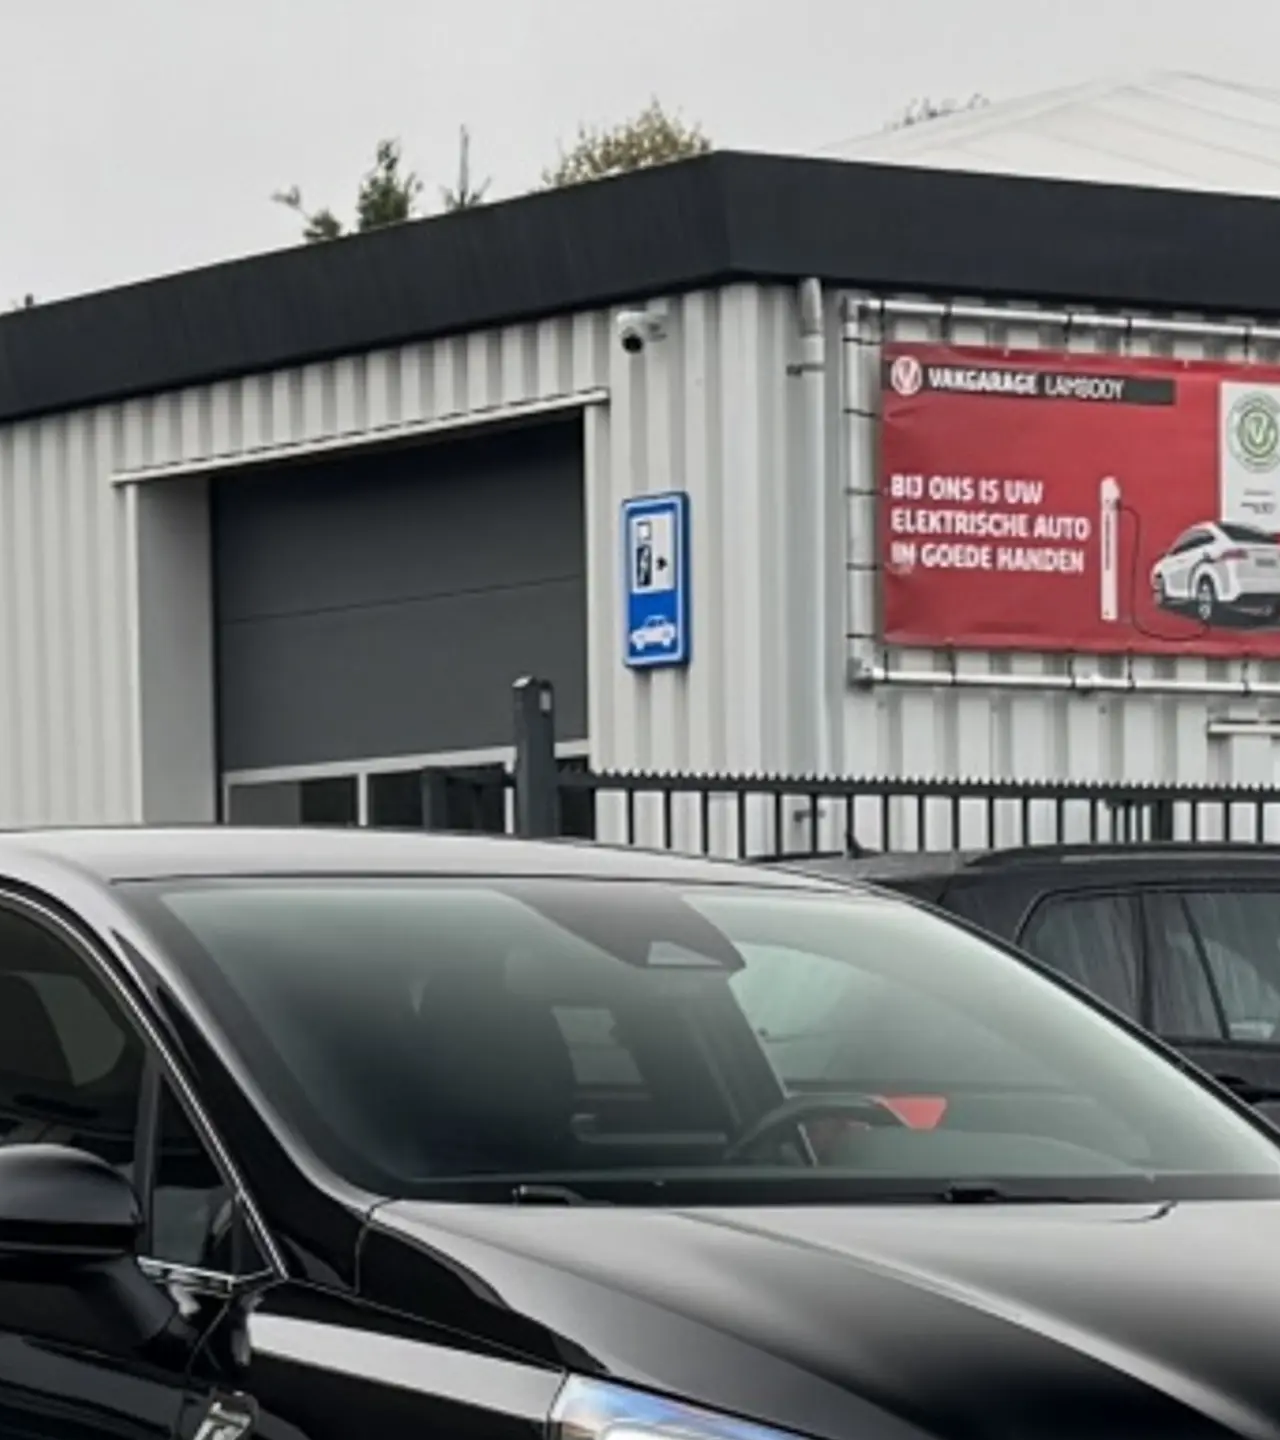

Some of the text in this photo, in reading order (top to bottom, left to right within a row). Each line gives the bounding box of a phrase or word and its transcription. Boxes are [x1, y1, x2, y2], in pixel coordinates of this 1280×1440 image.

[927, 366, 1125, 399] VAKGARAGE LAMBOOY
[890, 473, 1044, 505] BIJ ONS IS UW
[890, 507, 1092, 542] ELEKTRISCHE AUTO
[890, 541, 1085, 573] IN GOEDE HANDEN
